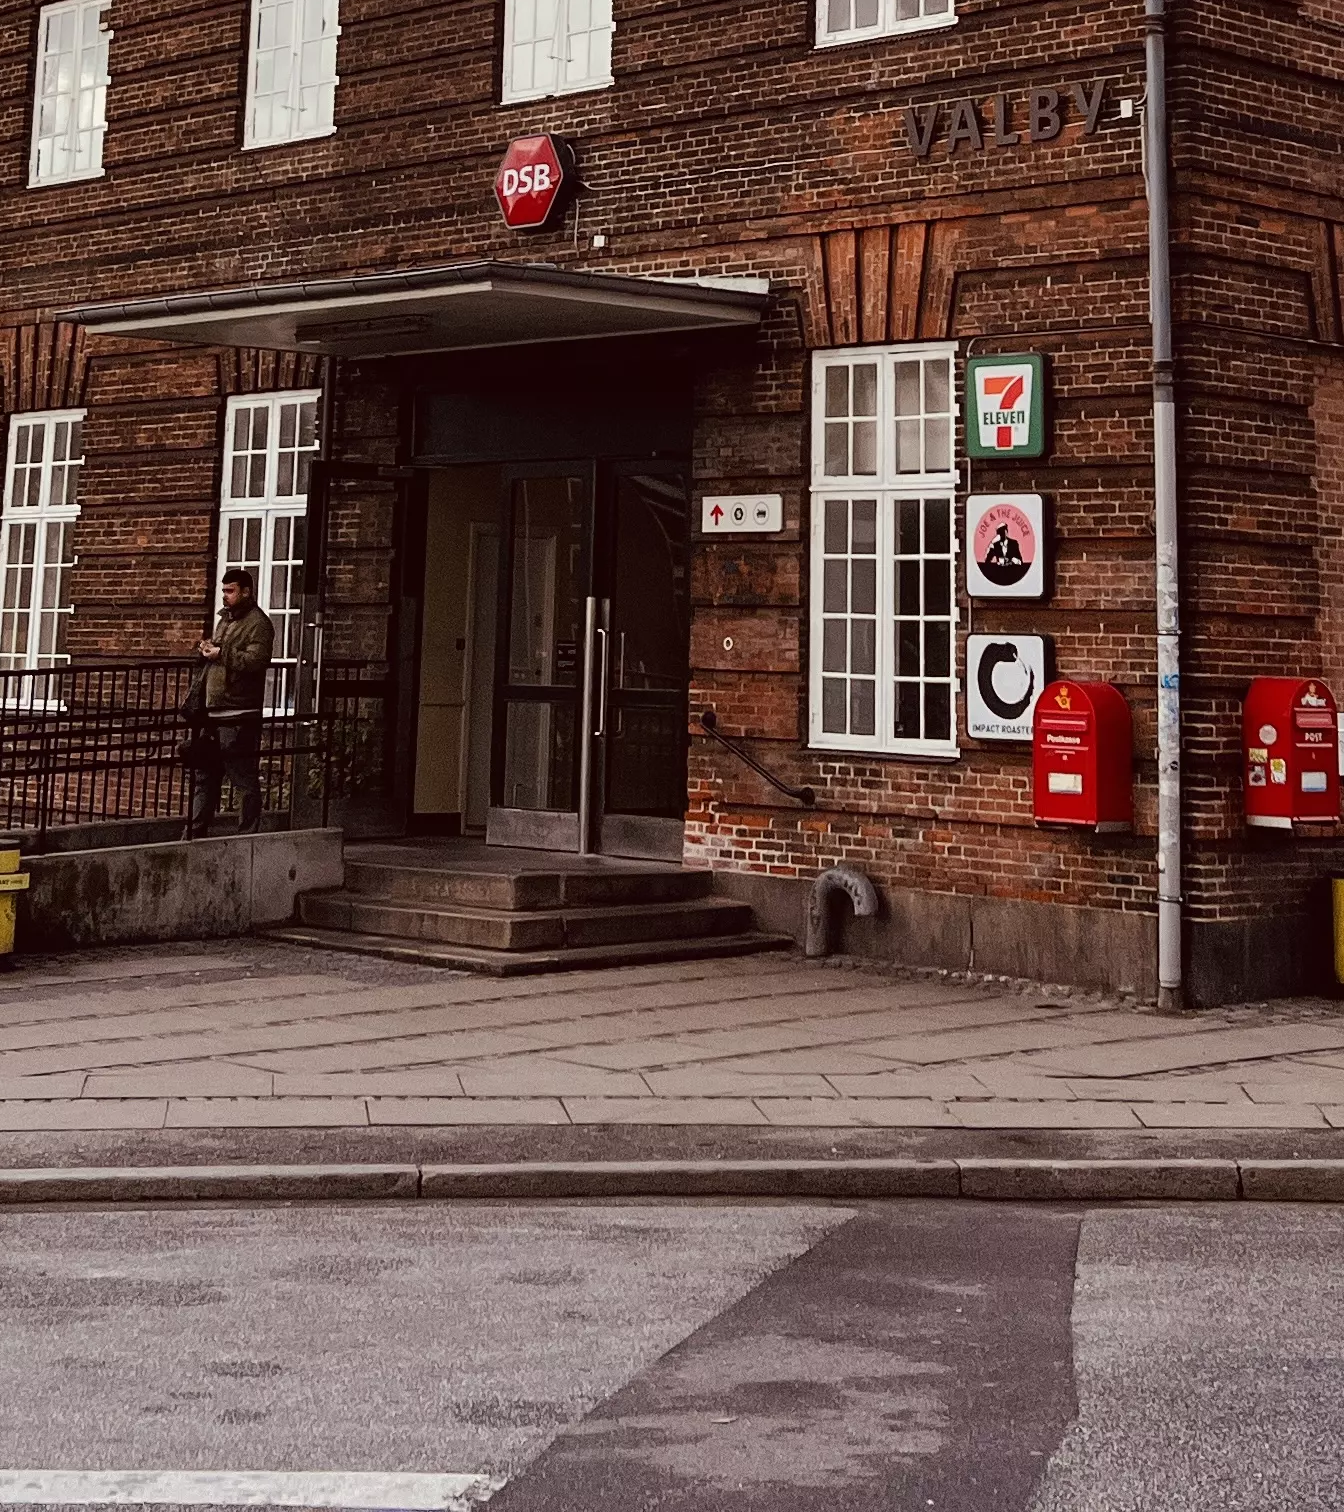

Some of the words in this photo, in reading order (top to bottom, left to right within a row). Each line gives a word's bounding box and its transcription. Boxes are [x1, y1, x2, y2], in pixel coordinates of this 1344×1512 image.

[904, 79, 1106, 156] VALBY
[503, 163, 551, 197] DSB
[984, 375, 1024, 448] 7
[978, 519, 990, 539] JOE
[997, 508, 1011, 519] THE
[972, 723, 1000, 734] IMPACT
[1304, 731, 1323, 743] POST
